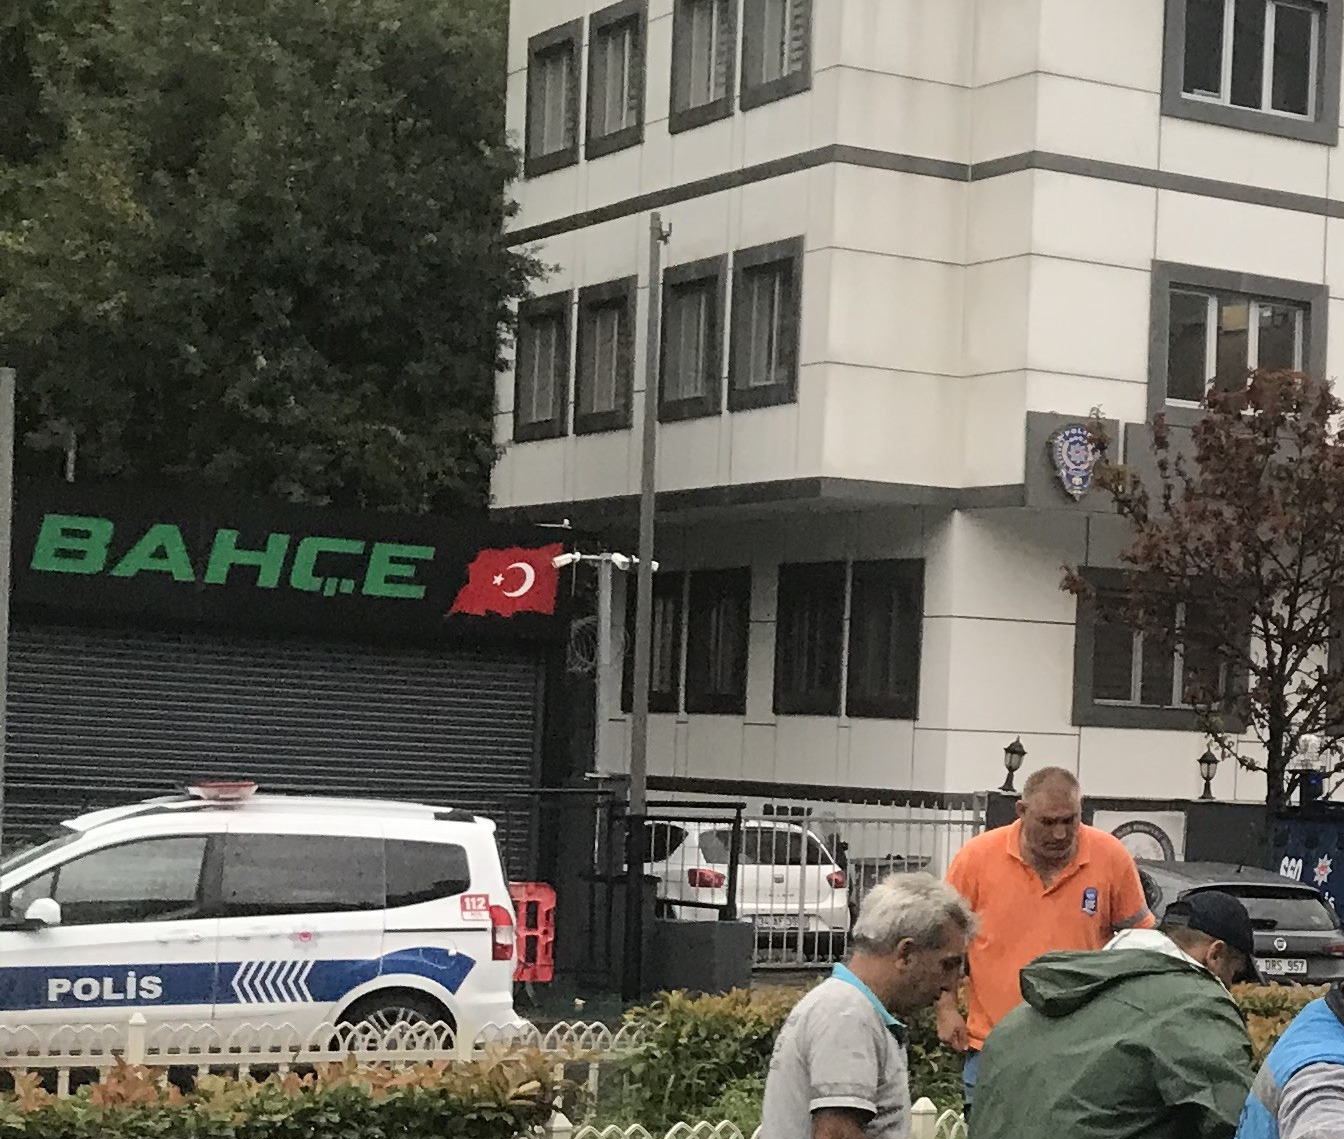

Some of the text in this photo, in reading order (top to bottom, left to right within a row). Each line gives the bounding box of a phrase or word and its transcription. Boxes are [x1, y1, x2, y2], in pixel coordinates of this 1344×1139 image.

[30, 512, 436, 599] BAHÇE
[464, 897, 487, 910] 112
[1265, 960, 1305, 972] DRS 957
[48, 970, 163, 1001] POLİS
